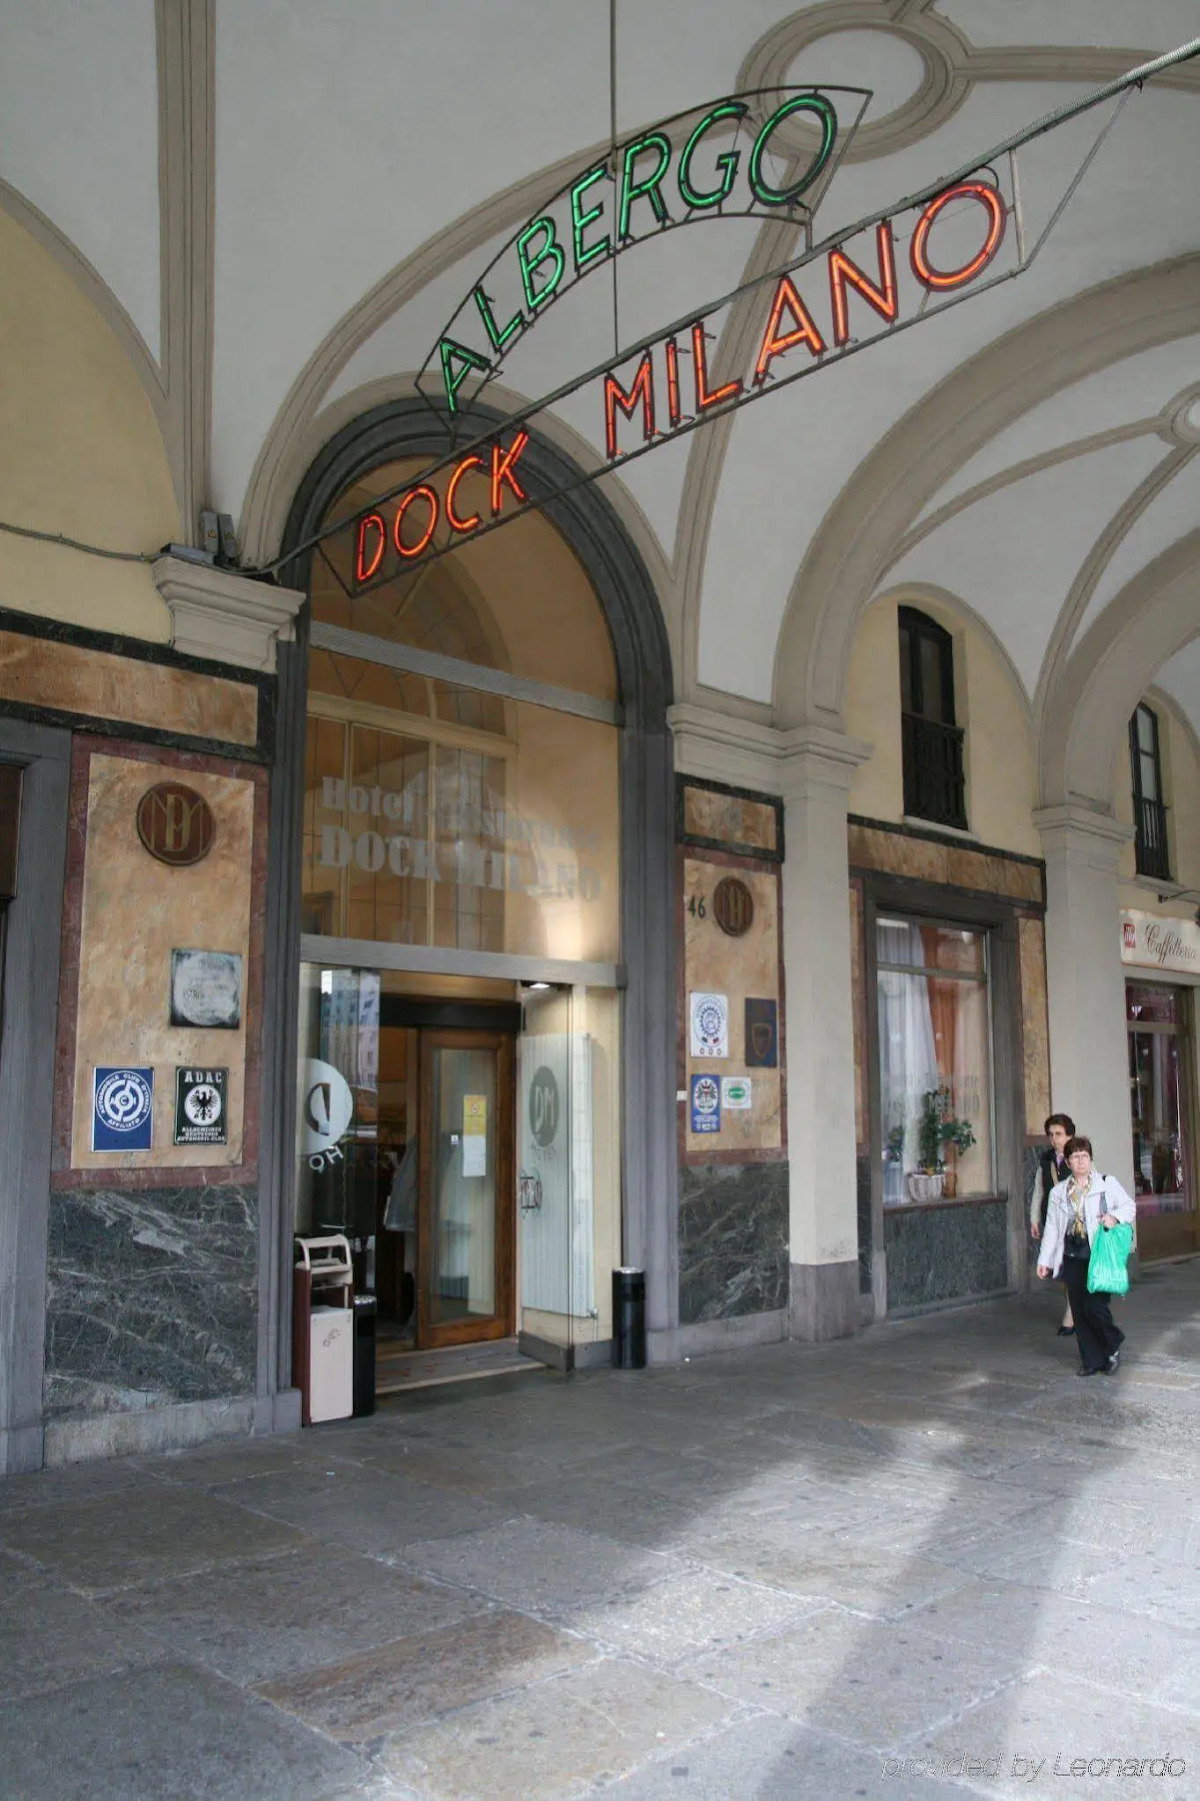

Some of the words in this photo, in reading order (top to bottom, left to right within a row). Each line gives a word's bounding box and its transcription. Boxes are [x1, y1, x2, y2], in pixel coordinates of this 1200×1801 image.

[440, 93, 837, 412] ALBERGO
[355, 425, 529, 582] DOCK
[604, 179, 1006, 460] MILANO
[320, 775, 415, 823] Hotel
[319, 824, 442, 882] DOCK
[688, 895, 706, 919] 46
[184, 1070, 223, 1083] ADAC
